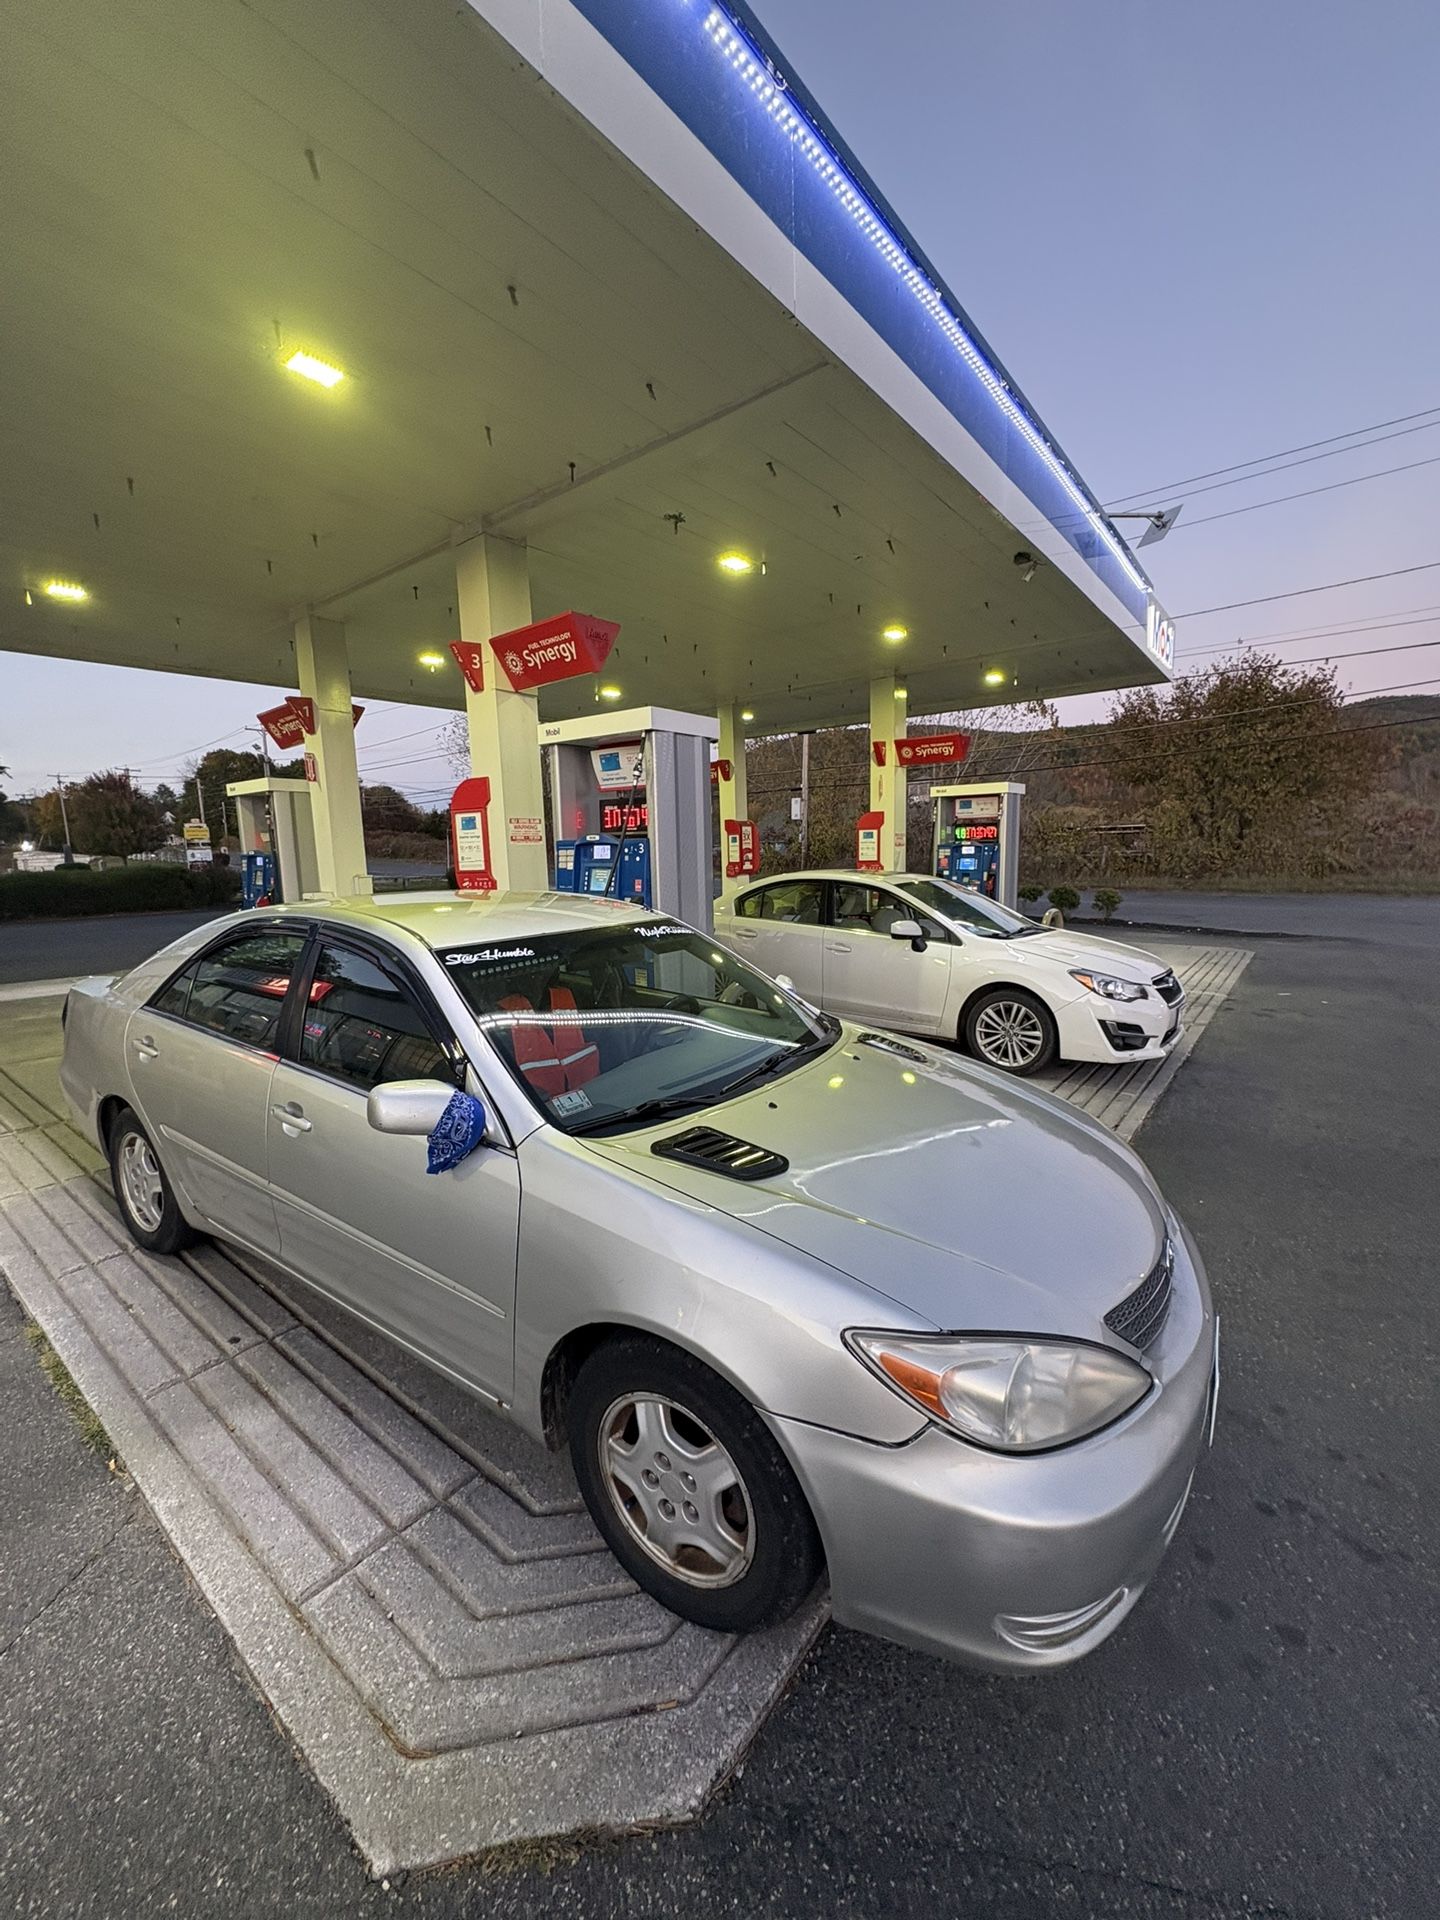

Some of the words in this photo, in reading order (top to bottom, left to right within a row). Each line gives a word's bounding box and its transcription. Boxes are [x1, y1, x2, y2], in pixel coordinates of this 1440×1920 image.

[528, 642, 540, 650] FUEL
[539, 632, 571, 647] TECHNOLOGY
[471, 653, 480, 669] 3
[522, 640, 577, 670] Synergy
[545, 727, 561, 737] Mobil
[915, 746, 955, 758] Synergy
[638, 843, 645, 854] 3
[445, 953, 480, 966] Stay
[481, 947, 536, 961] Humble
